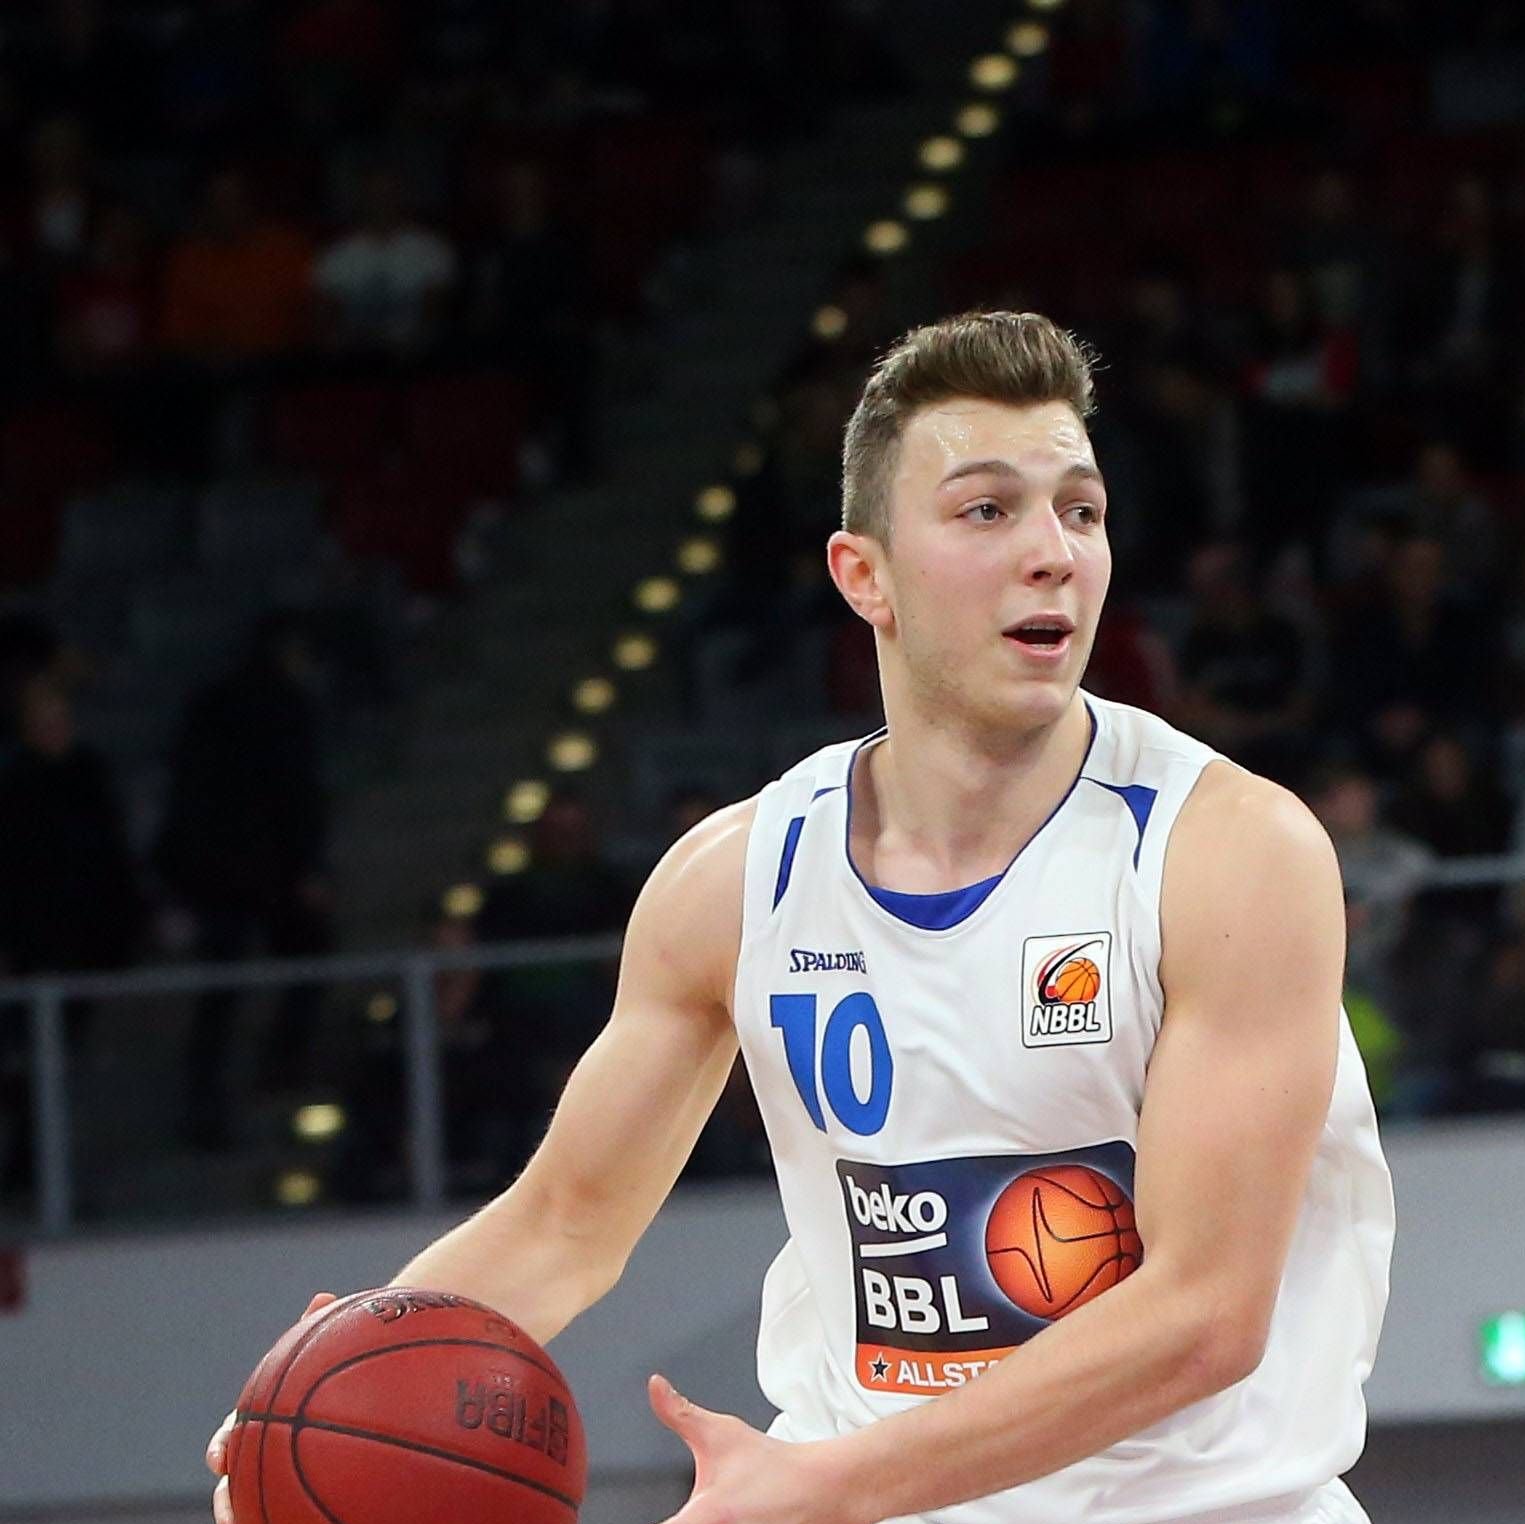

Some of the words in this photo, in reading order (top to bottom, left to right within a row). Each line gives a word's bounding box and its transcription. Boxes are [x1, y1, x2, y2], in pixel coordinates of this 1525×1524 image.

[789, 948, 867, 975] SPALDING
[1029, 1003, 1101, 1037] NBBL
[769, 990, 894, 1136] 10
[844, 1175, 948, 1234] beko
[861, 1267, 990, 1335] BBL
[896, 1359, 999, 1388] ALLST
